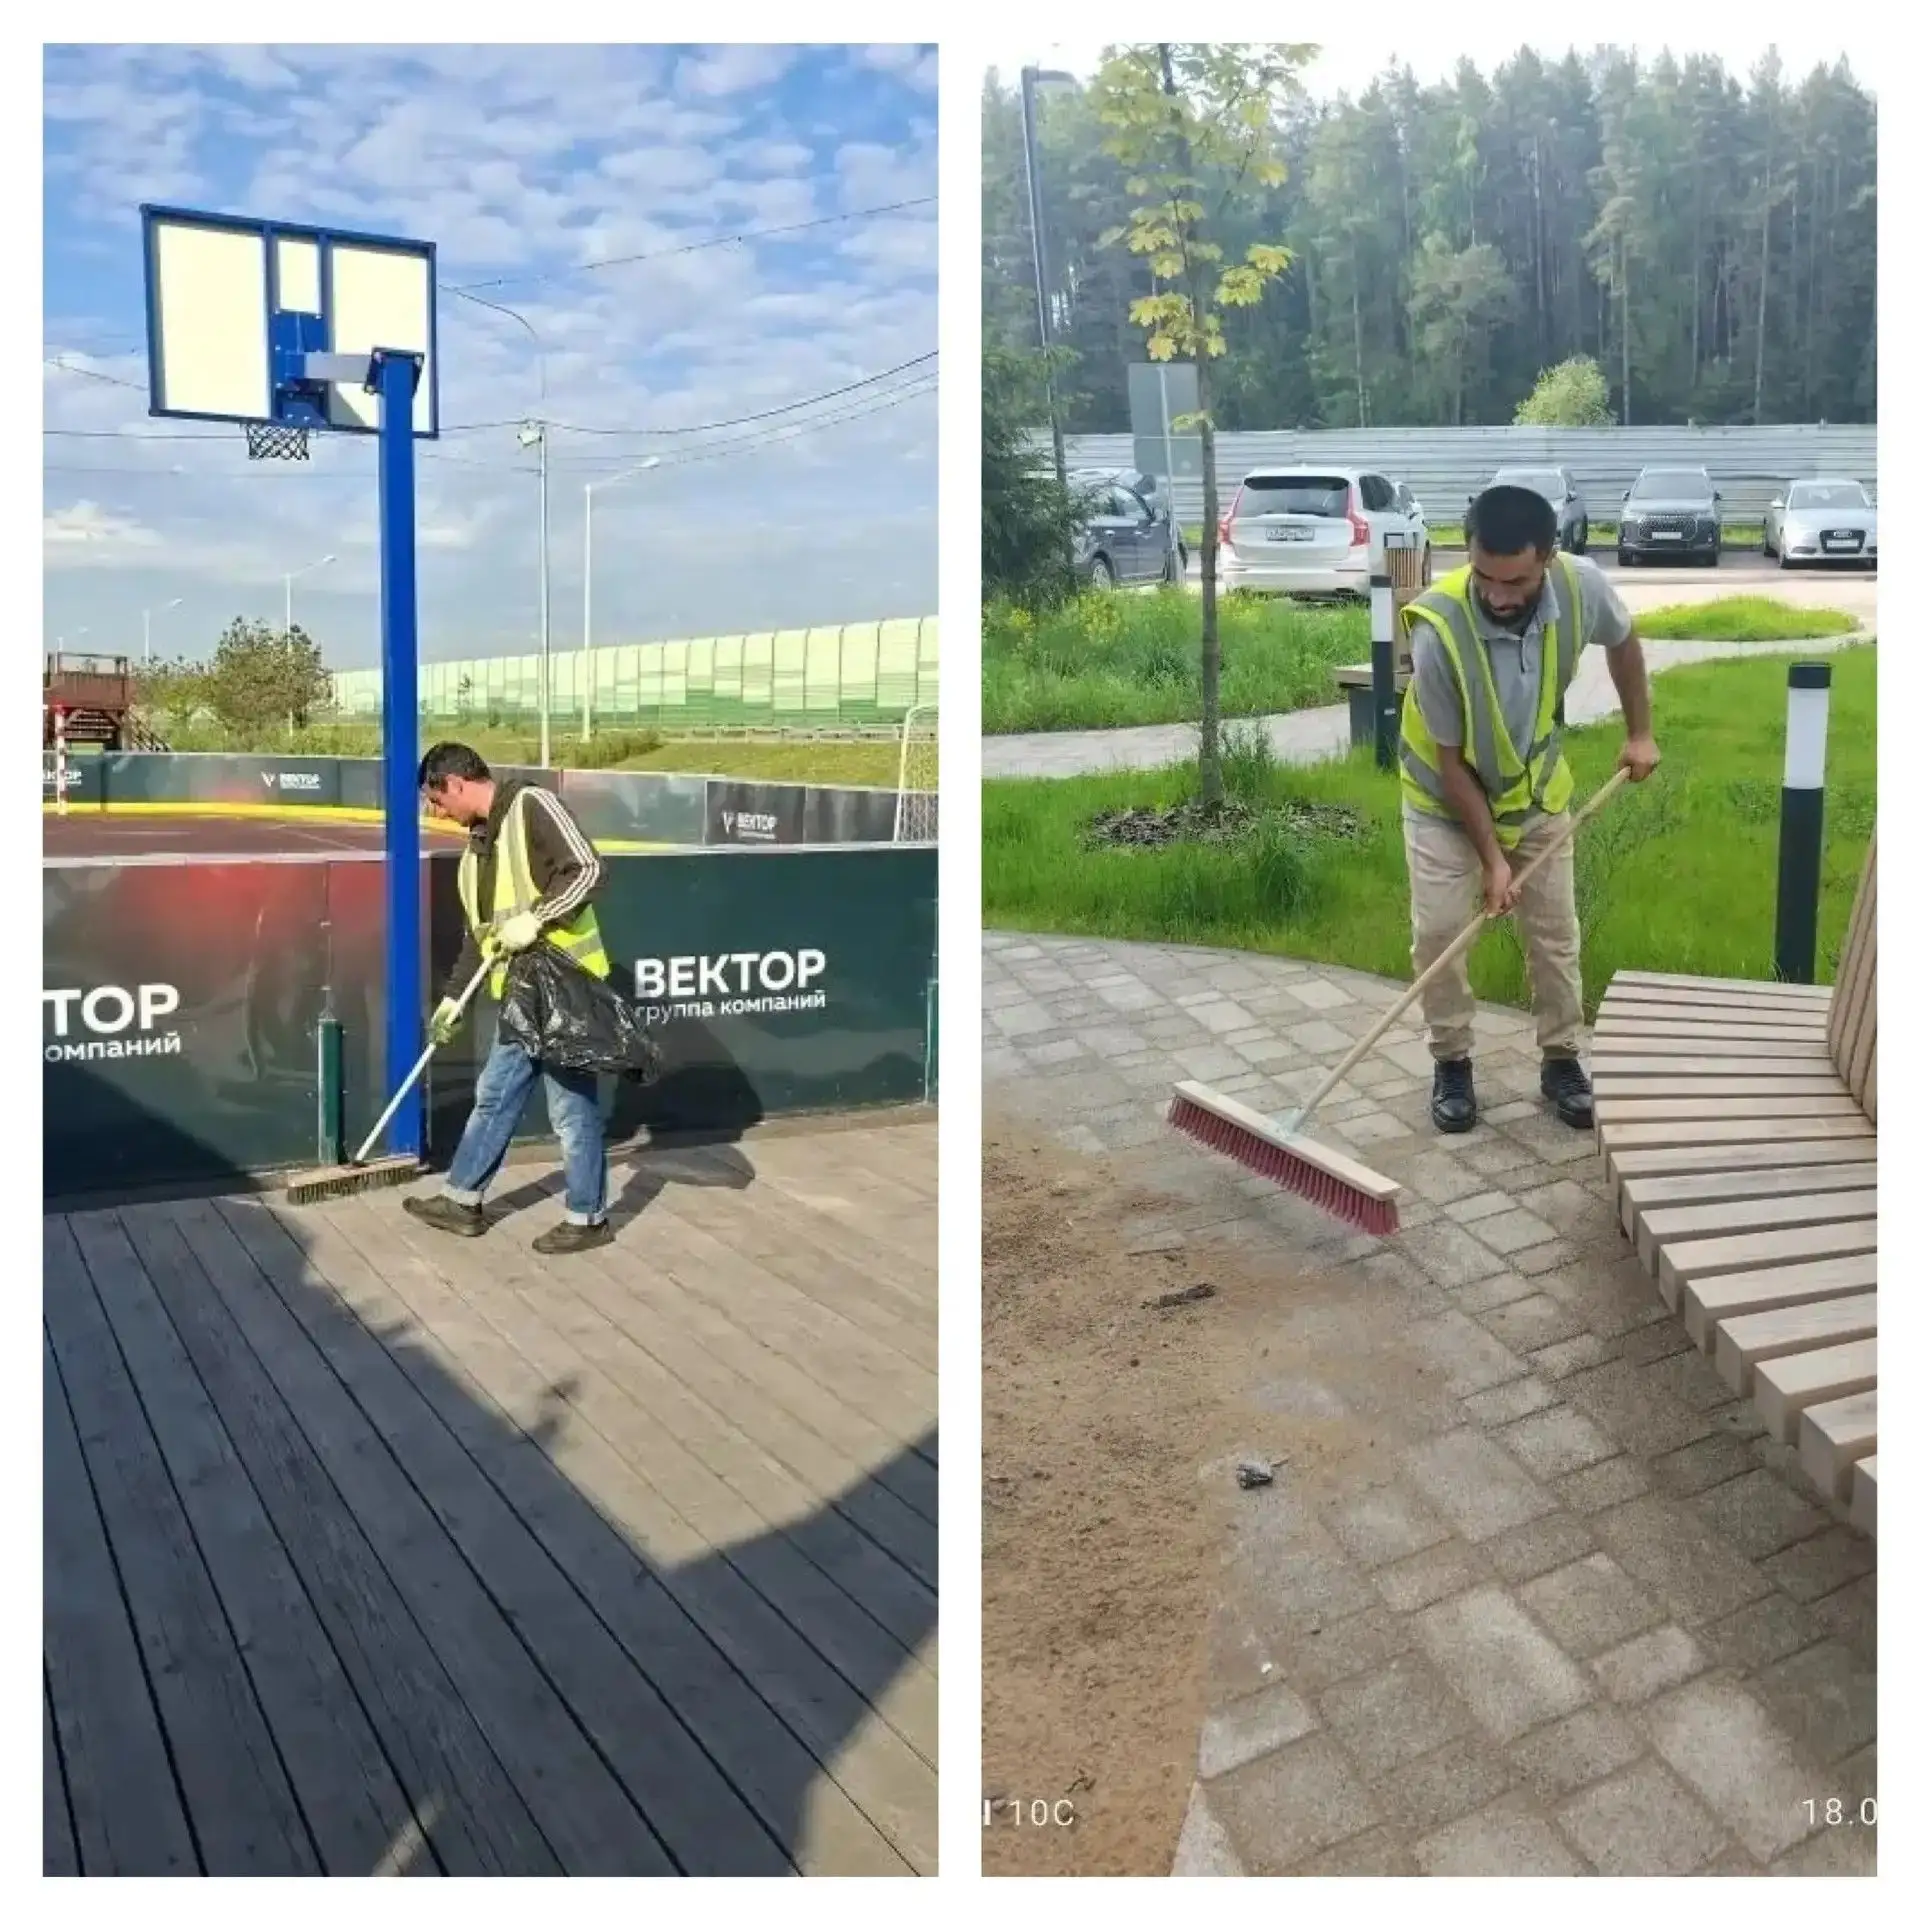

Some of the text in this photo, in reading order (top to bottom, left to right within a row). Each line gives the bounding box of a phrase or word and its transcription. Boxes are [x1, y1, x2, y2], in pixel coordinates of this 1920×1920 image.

[634, 949, 826, 998] ВЕКТОР
[635, 989, 826, 1026] группа компаний
